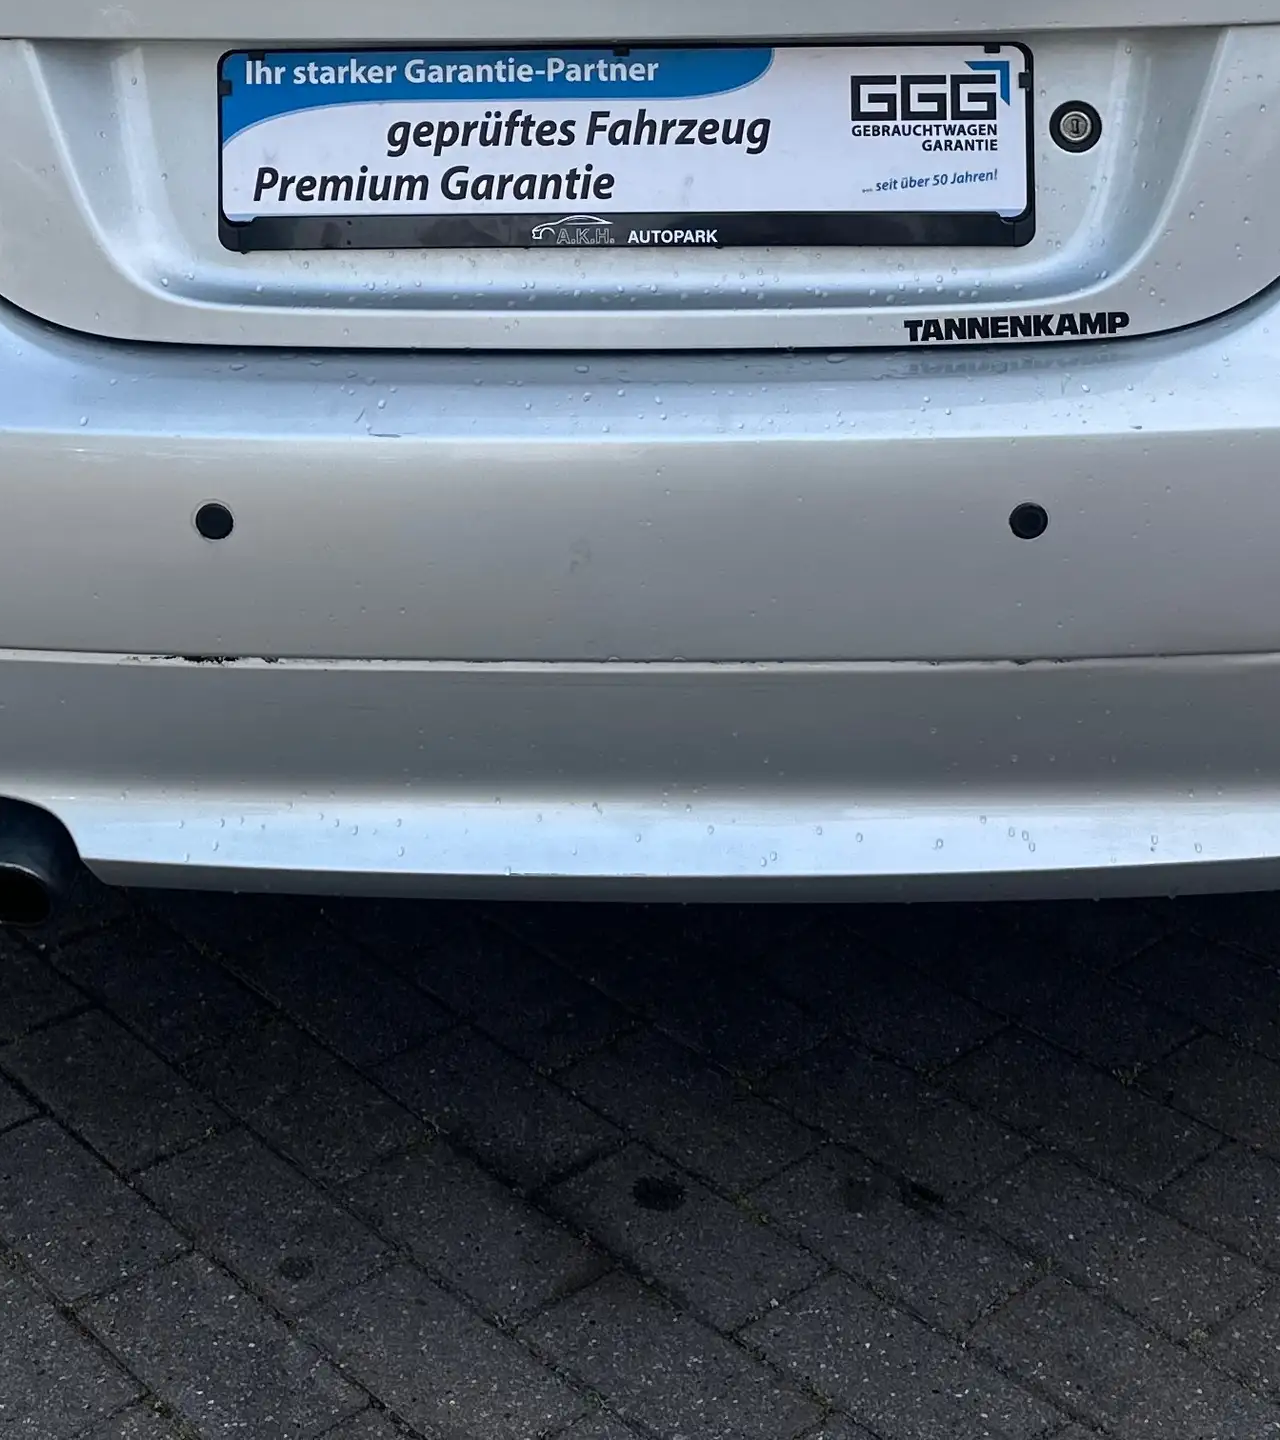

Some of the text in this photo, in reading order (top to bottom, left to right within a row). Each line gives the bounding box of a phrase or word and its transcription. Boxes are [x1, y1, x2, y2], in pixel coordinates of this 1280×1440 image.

[245, 57, 659, 85] Ihr starker Garantie-Partner
[851, 74, 997, 121] GGG
[386, 108, 772, 158] geprüftes Fahrzeug
[851, 123, 998, 137] GEBRAUCHTWAGEN
[921, 138, 998, 152] GARANTIE
[253, 163, 615, 202] Premium Garantie
[875, 178, 898, 192] seit
[900, 176, 930, 190] über
[932, 173, 948, 186] 50
[950, 169, 998, 185] Jahren!
[556, 227, 718, 245] A.K.H. AUTOPARK
[903, 311, 1131, 343] TANNENKAMP
